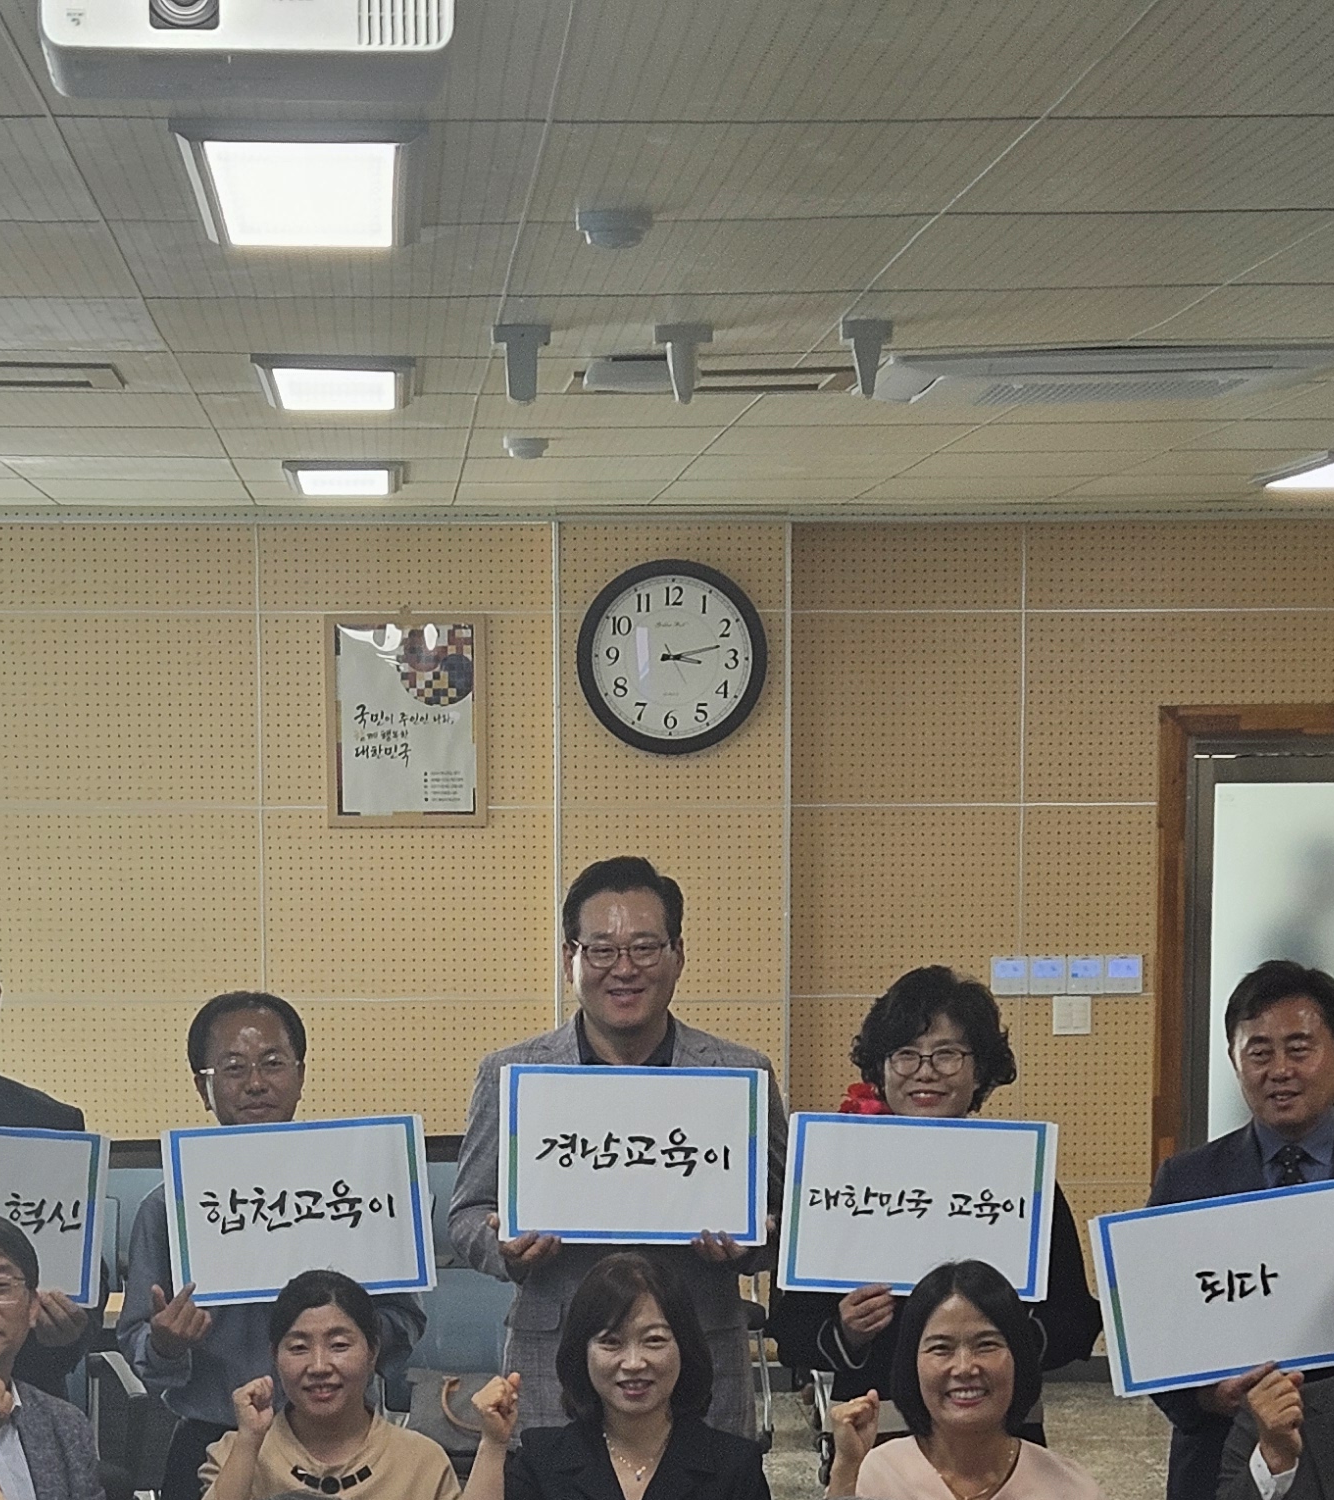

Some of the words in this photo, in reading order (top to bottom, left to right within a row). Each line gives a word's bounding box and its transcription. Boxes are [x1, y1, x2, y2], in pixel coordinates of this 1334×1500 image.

[636, 593, 651, 613] 11
[664, 585, 684, 606] 12
[701, 594, 707, 614] 1
[611, 615, 633, 636] 10
[719, 618, 731, 638] 2
[605, 646, 620, 666] 9
[724, 648, 739, 670] 3
[612, 676, 628, 697] 8
[715, 679, 729, 699] 4
[353, 703, 394, 729] 국민이
[398, 711, 429, 727] 주인인
[634, 702, 648, 721] 7
[663, 709, 678, 730] 6
[694, 702, 708, 722] 5
[354, 742, 412, 768] 대한민국
[535, 1127, 730, 1178] 경남교육이
[5, 1193, 82, 1235] 혁신
[199, 1179, 396, 1235] 합천교육이
[808, 1184, 933, 1219] 대한민국
[947, 1188, 1026, 1226] 교육이
[1195, 1264, 1279, 1304] 되다
